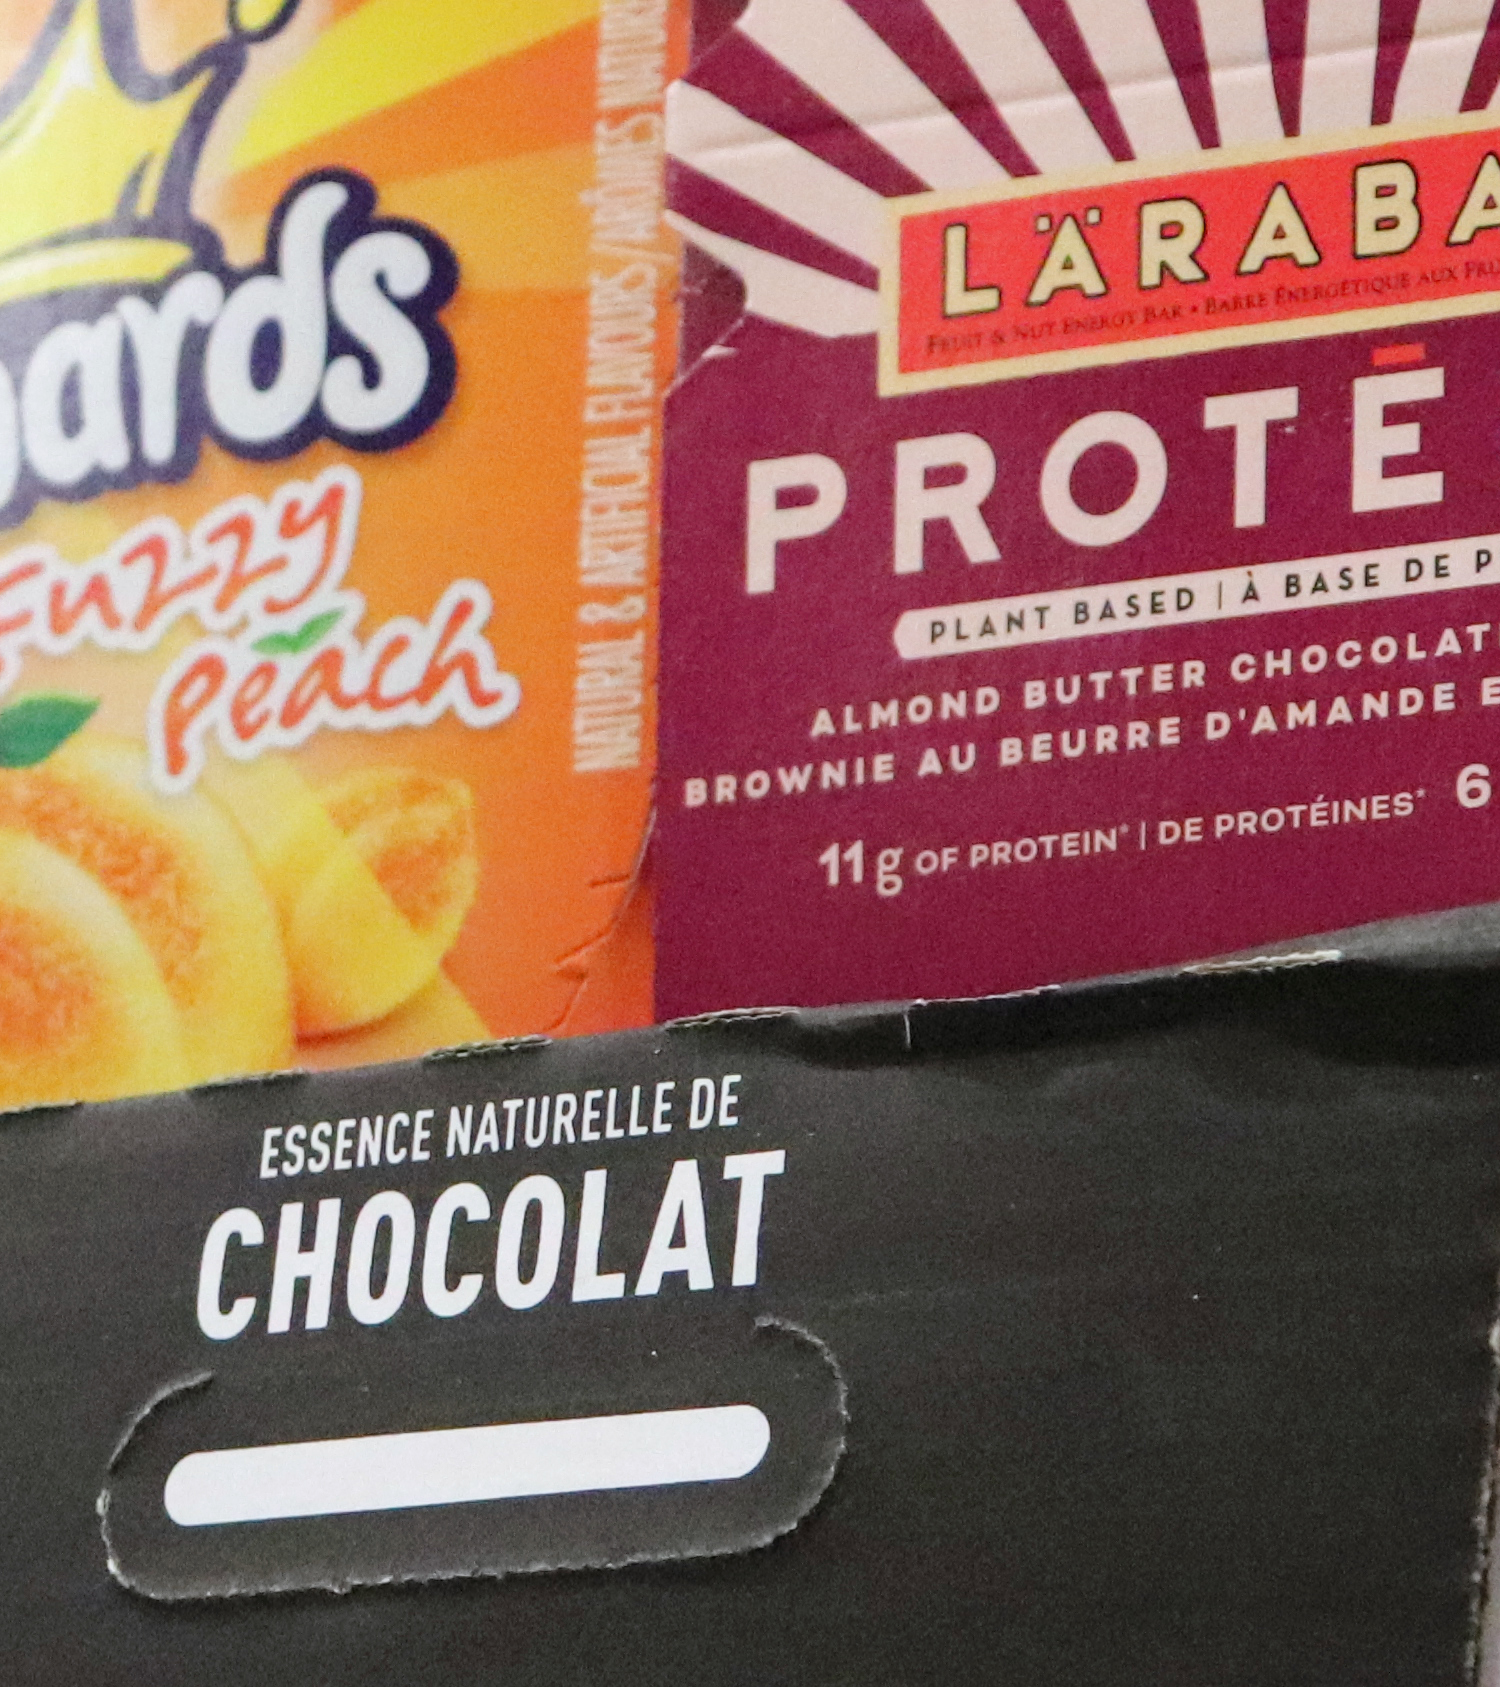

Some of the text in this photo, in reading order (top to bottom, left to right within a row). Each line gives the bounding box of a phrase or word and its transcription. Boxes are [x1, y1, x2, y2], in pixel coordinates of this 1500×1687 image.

[579, 426, 651, 587] ARTIFICIAL
[579, 596, 643, 626] &
[929, 604, 1051, 645] PLANT
[1074, 588, 1197, 625] BASED
[1241, 569, 1261, 604] À
[1283, 562, 1382, 597] BASE
[1404, 552, 1452, 580] DE
[573, 629, 643, 773] NATURAL
[683, 752, 896, 808] BROWNIE
[917, 743, 979, 777] AU
[999, 715, 1182, 768] BEURRE
[1204, 681, 1458, 742] D'AMANDE
[810, 686, 1001, 738] ALMOND
[1023, 658, 1207, 709] BUTTER
[914, 845, 959, 877] OF
[1157, 815, 1204, 847] DE
[1455, 762, 1493, 809] 6
[258, 1073, 742, 1180] ESSENCE NATURELLE DE
[194, 1147, 787, 1342] CHOCOLAT
